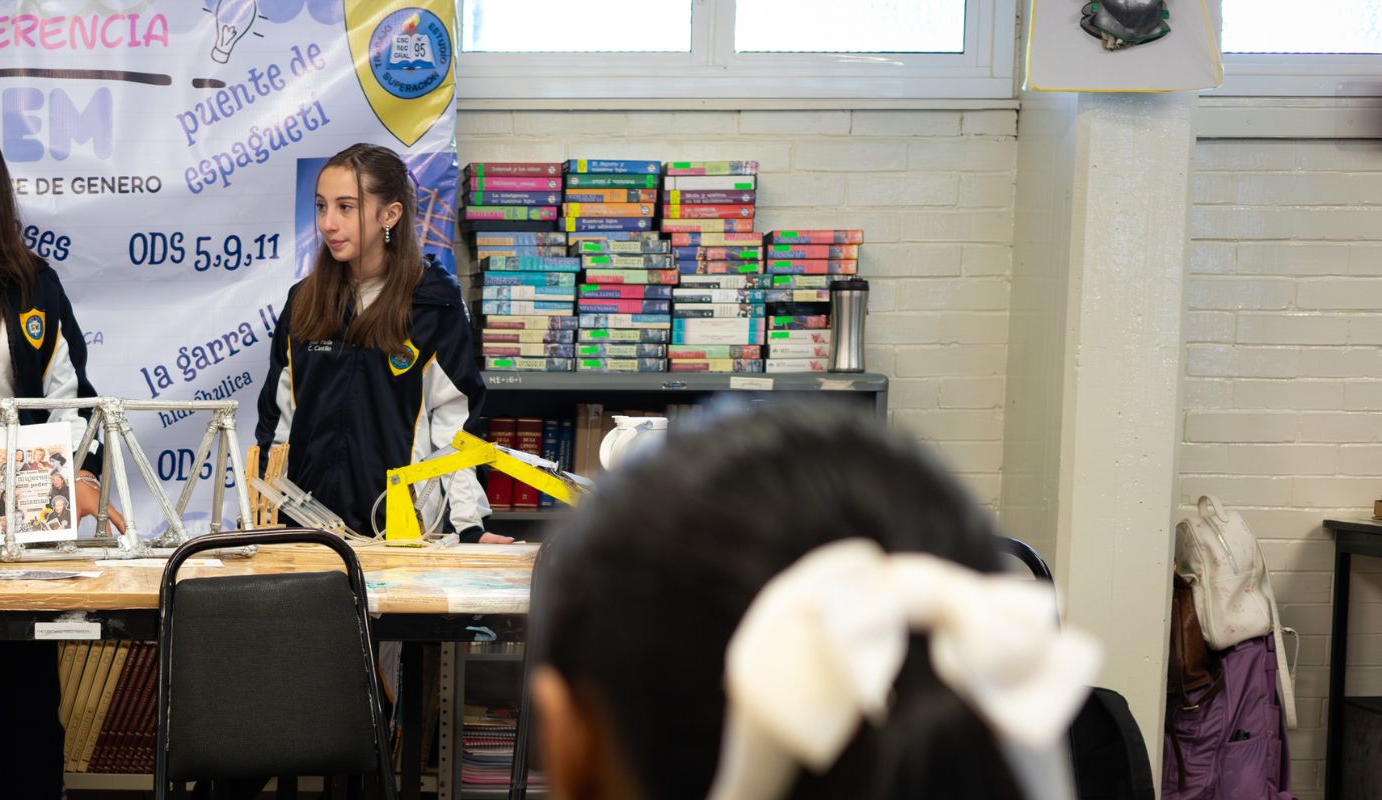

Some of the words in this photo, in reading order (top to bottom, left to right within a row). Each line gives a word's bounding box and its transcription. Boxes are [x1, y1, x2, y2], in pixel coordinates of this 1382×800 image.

[414, 42, 426, 57] 95
[176, 64, 286, 147] puente
[290, 43, 326, 77] de
[184, 92, 331, 194] espagueti
[35, 177, 64, 195] DE
[71, 176, 162, 195] GENERO
[128, 232, 185, 265] ODS
[140, 364, 174, 399] la
[176, 322, 258, 383] garra
